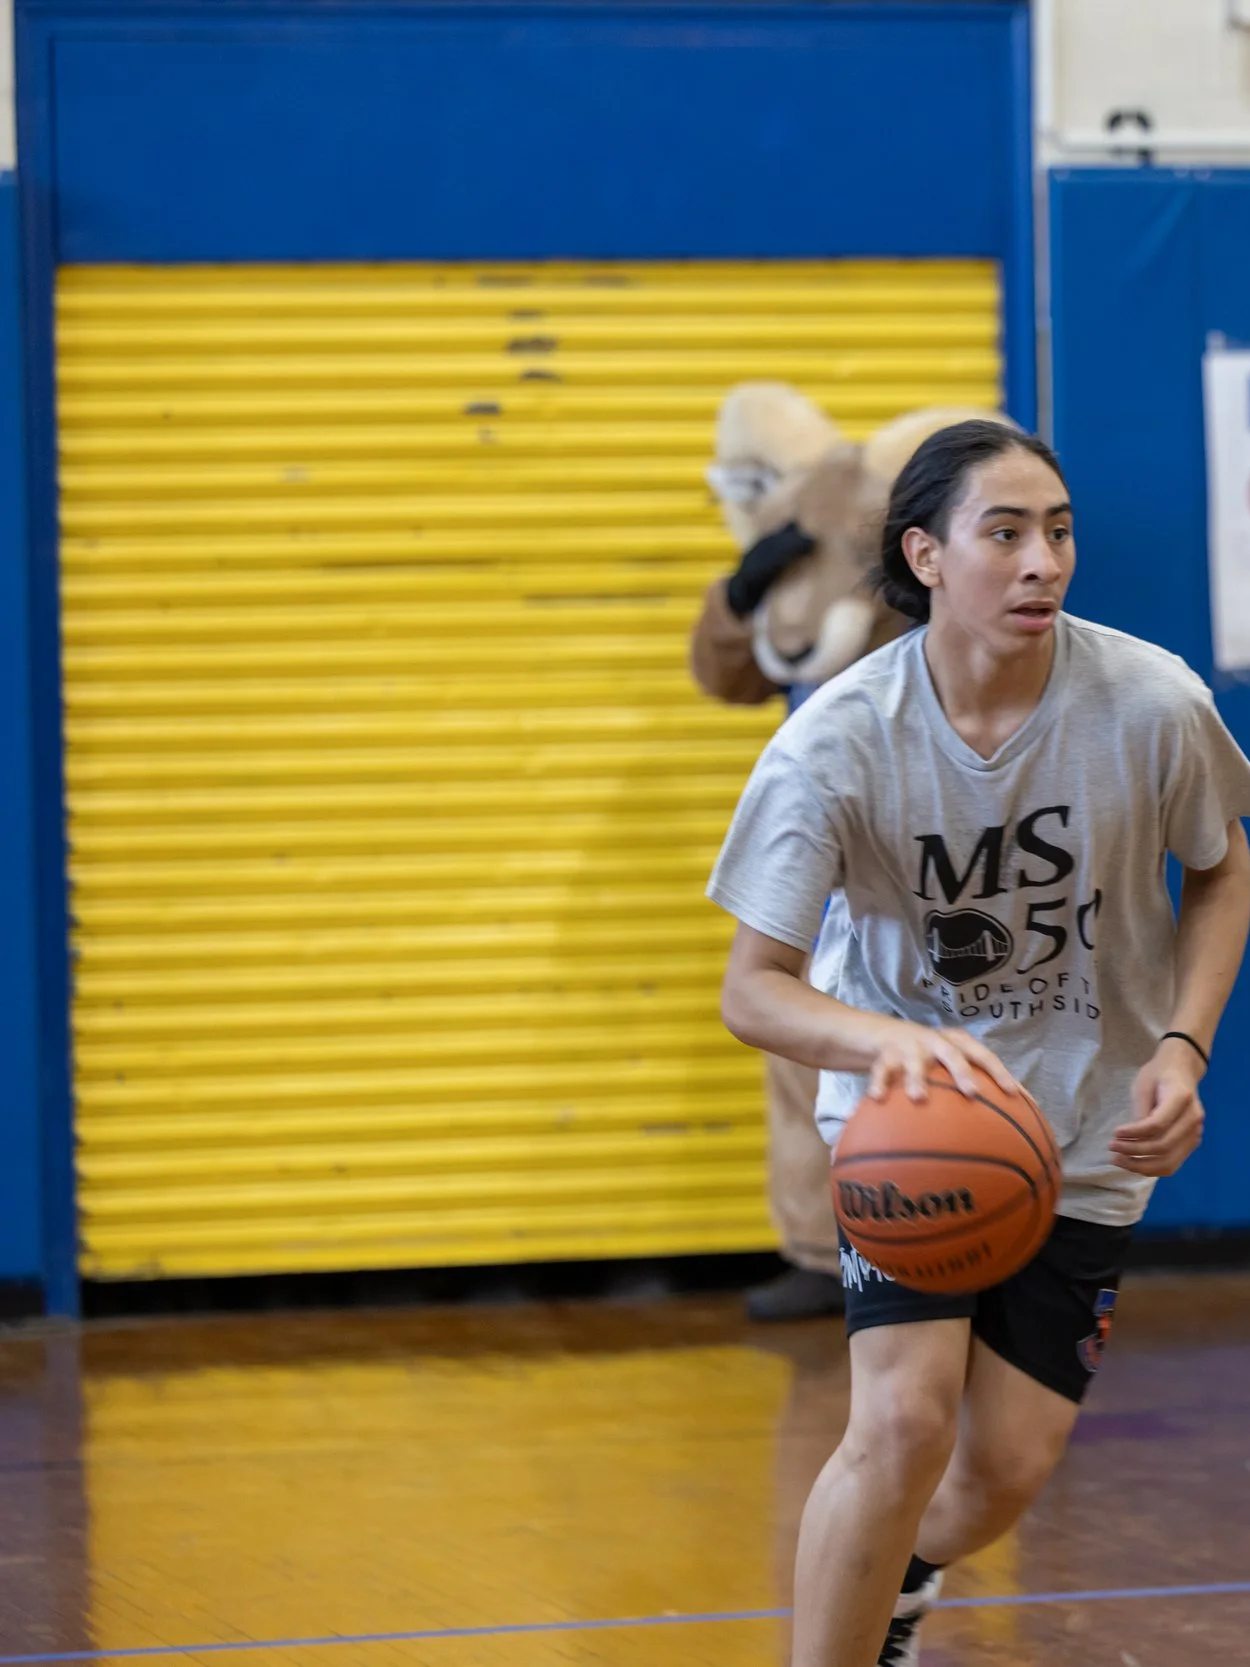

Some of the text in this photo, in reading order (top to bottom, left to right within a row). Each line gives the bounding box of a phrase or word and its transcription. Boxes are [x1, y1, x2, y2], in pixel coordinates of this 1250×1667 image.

[912, 805, 1075, 905] MS
[1029, 972, 1069, 995] OF
[837, 1179, 976, 1221] Wilson
